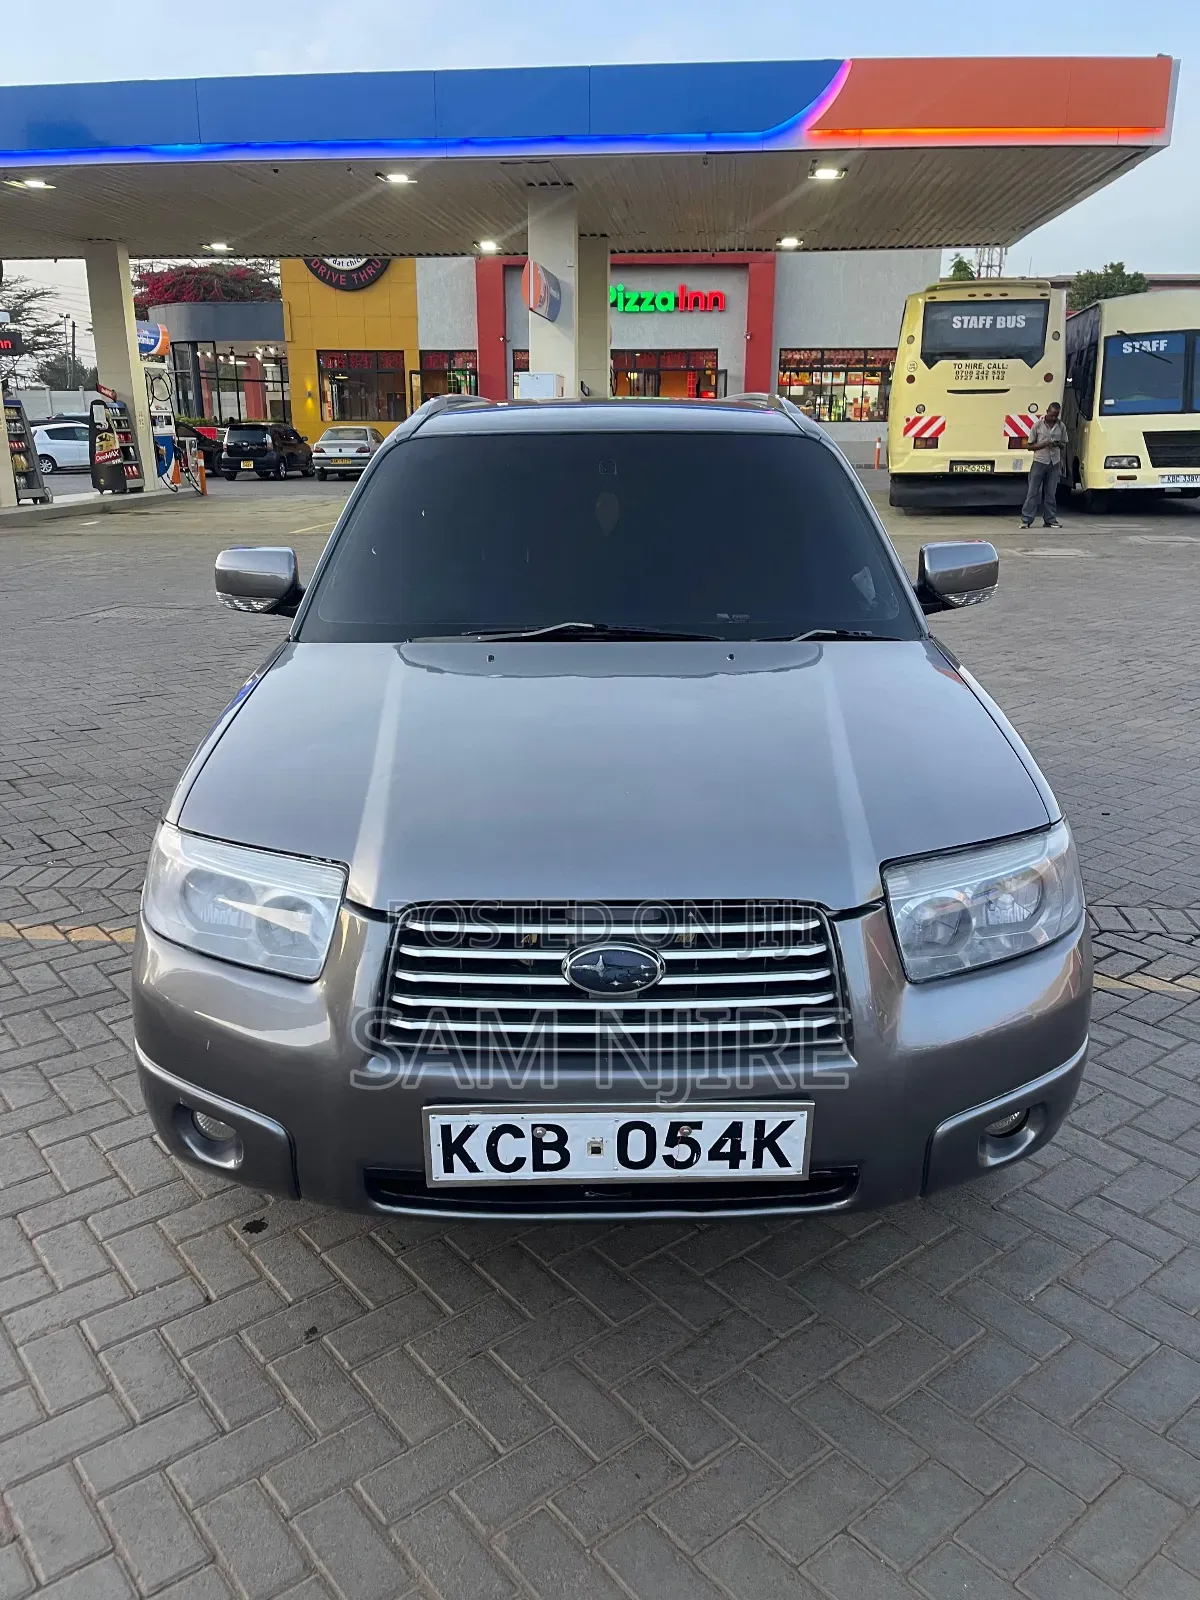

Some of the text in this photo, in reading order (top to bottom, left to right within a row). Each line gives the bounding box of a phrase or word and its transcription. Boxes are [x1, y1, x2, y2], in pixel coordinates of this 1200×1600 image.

[311, 258, 382, 286] DRIVE THRU
[678, 284, 725, 312] Inn
[952, 315, 1026, 329] STAFF BUS
[1122, 339, 1168, 354] STAFF
[953, 362, 963, 370] TO
[964, 362, 985, 371] HIRE,
[439, 1119, 797, 1174] KCB 054K
